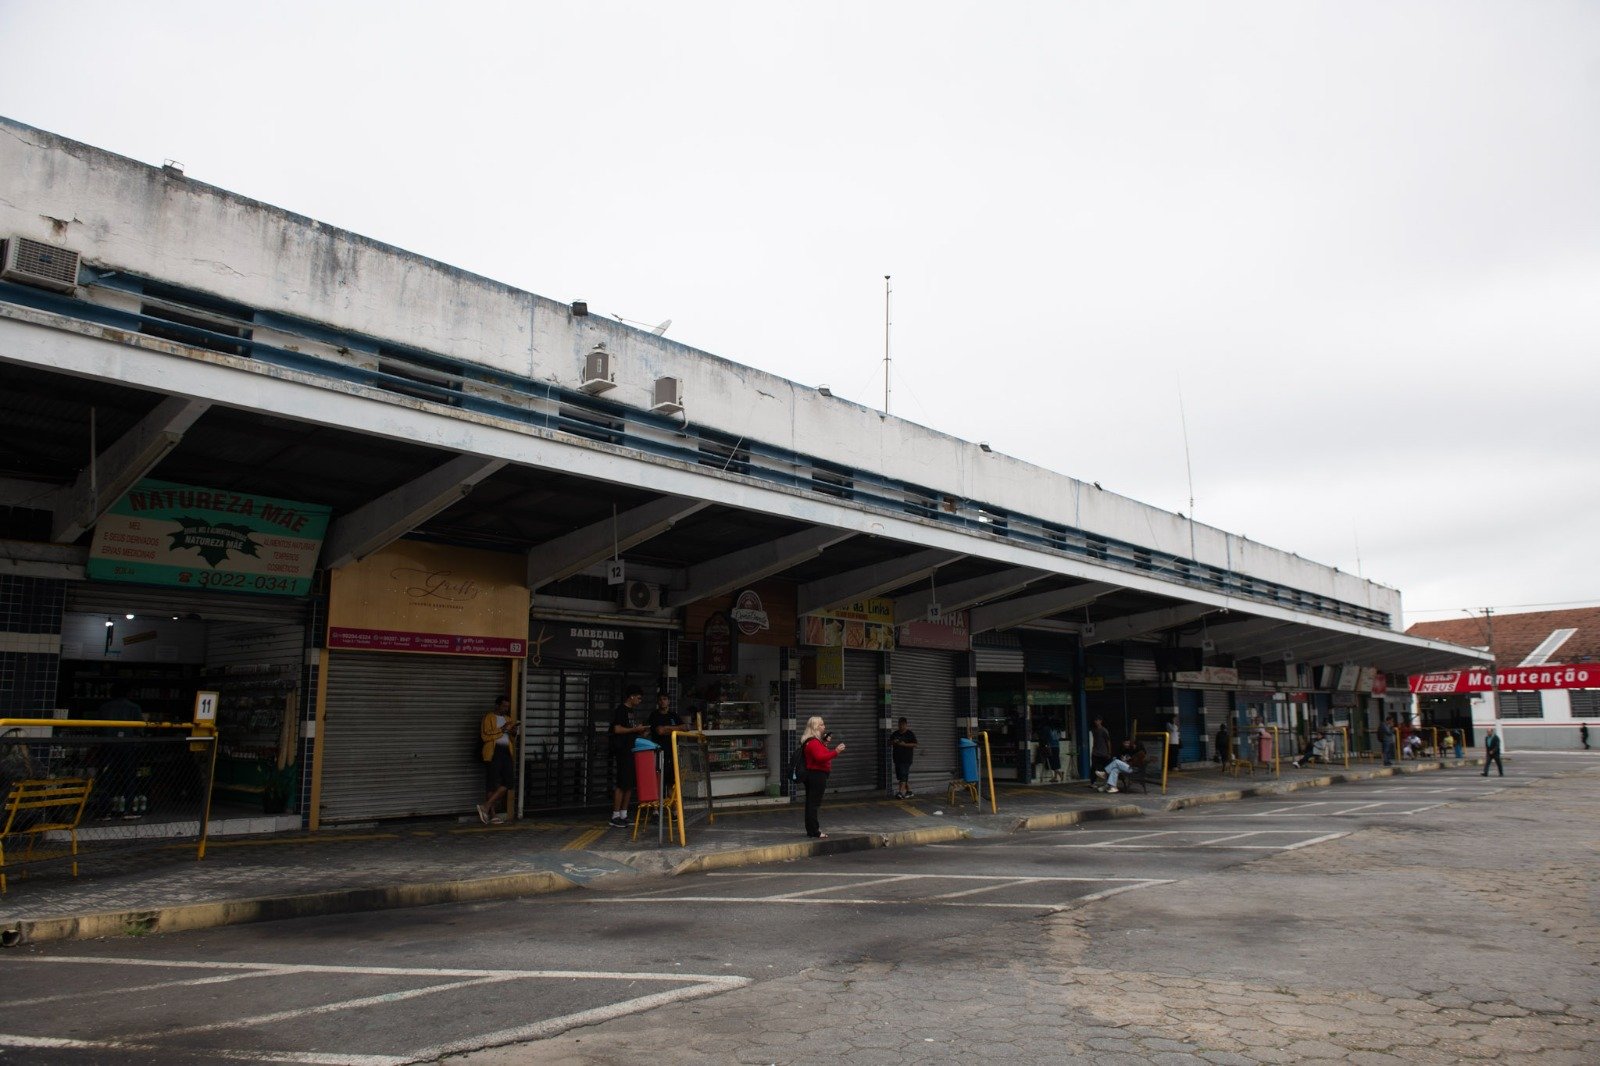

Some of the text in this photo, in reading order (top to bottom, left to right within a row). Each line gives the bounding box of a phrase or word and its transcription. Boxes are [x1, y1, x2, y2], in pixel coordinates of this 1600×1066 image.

[128, 489, 309, 532] NATUREZA MÃE
[185, 535, 224, 548] NATUREZA
[611, 566, 621, 578] 12
[198, 571, 298, 592] 3022-0341
[868, 599, 890, 616] Linha
[930, 608, 938, 616] 13
[570, 628, 625, 641] BARBEARIA
[591, 640, 605, 649] DO
[576, 648, 619, 659] TARCÍSIO
[1467, 668, 1589, 686] Manutenção
[1423, 683, 1455, 691] NEUS
[202, 699, 211, 713] 11
